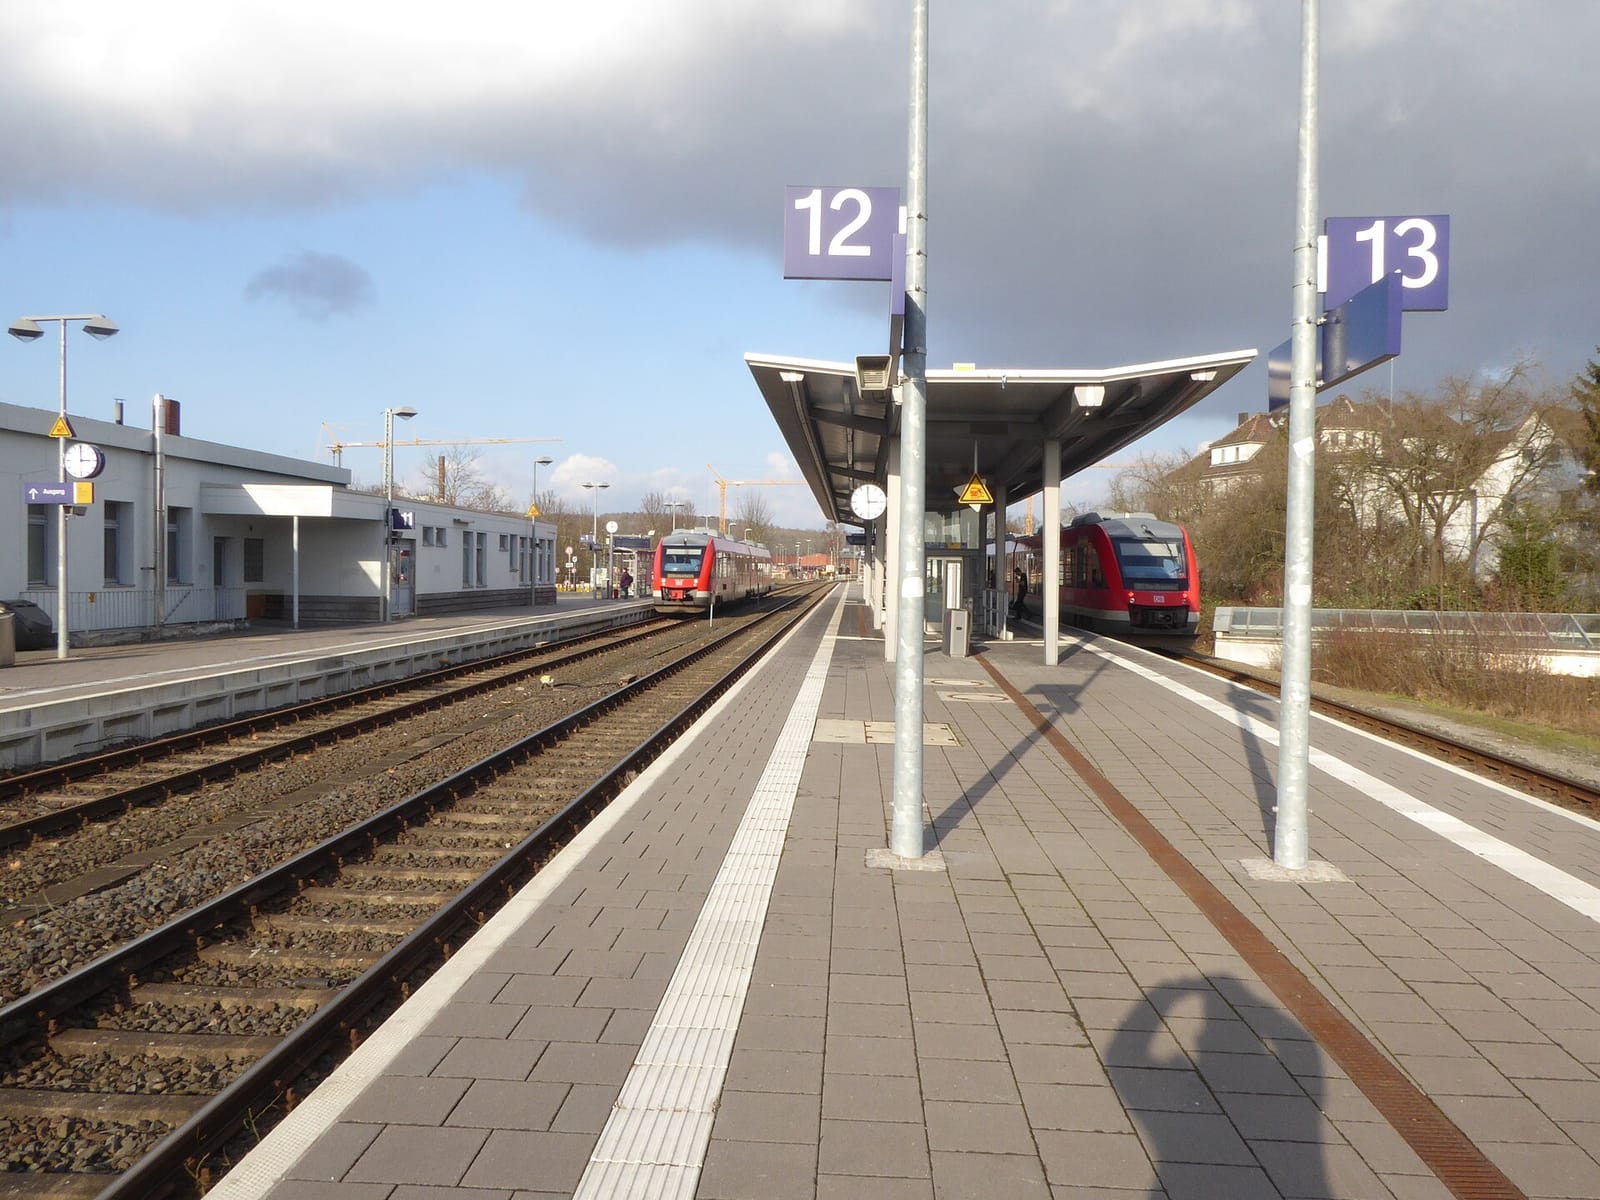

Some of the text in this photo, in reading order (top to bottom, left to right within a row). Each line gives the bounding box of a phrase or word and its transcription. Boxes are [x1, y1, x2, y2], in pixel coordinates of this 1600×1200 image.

[794, 188, 872, 257] 12
[1355, 218, 1439, 289] 13
[400, 511, 413, 526] 11
